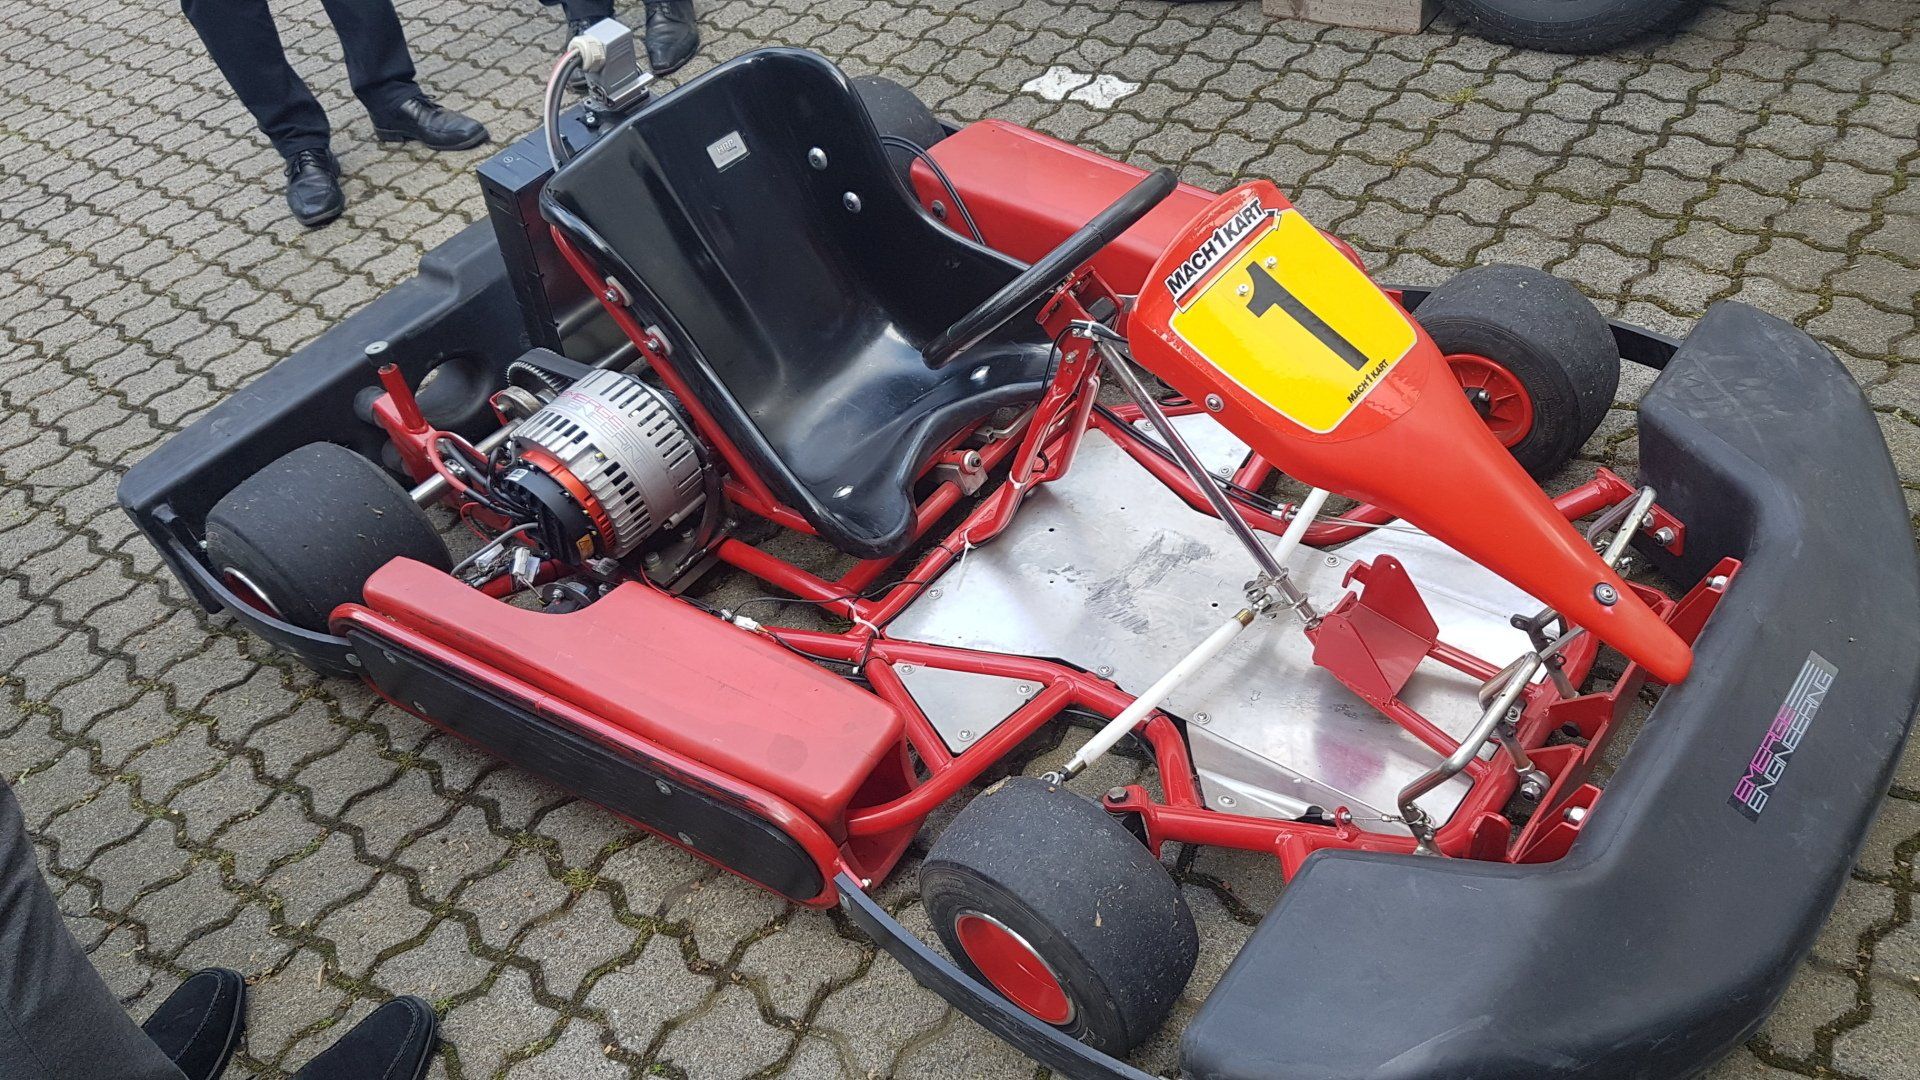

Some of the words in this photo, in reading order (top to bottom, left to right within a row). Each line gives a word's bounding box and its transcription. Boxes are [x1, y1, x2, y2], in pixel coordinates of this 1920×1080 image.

[1246, 261, 1369, 371] 1
[1733, 703, 1796, 804] EMERGE
[1747, 673, 1834, 814] ENGINEERING
